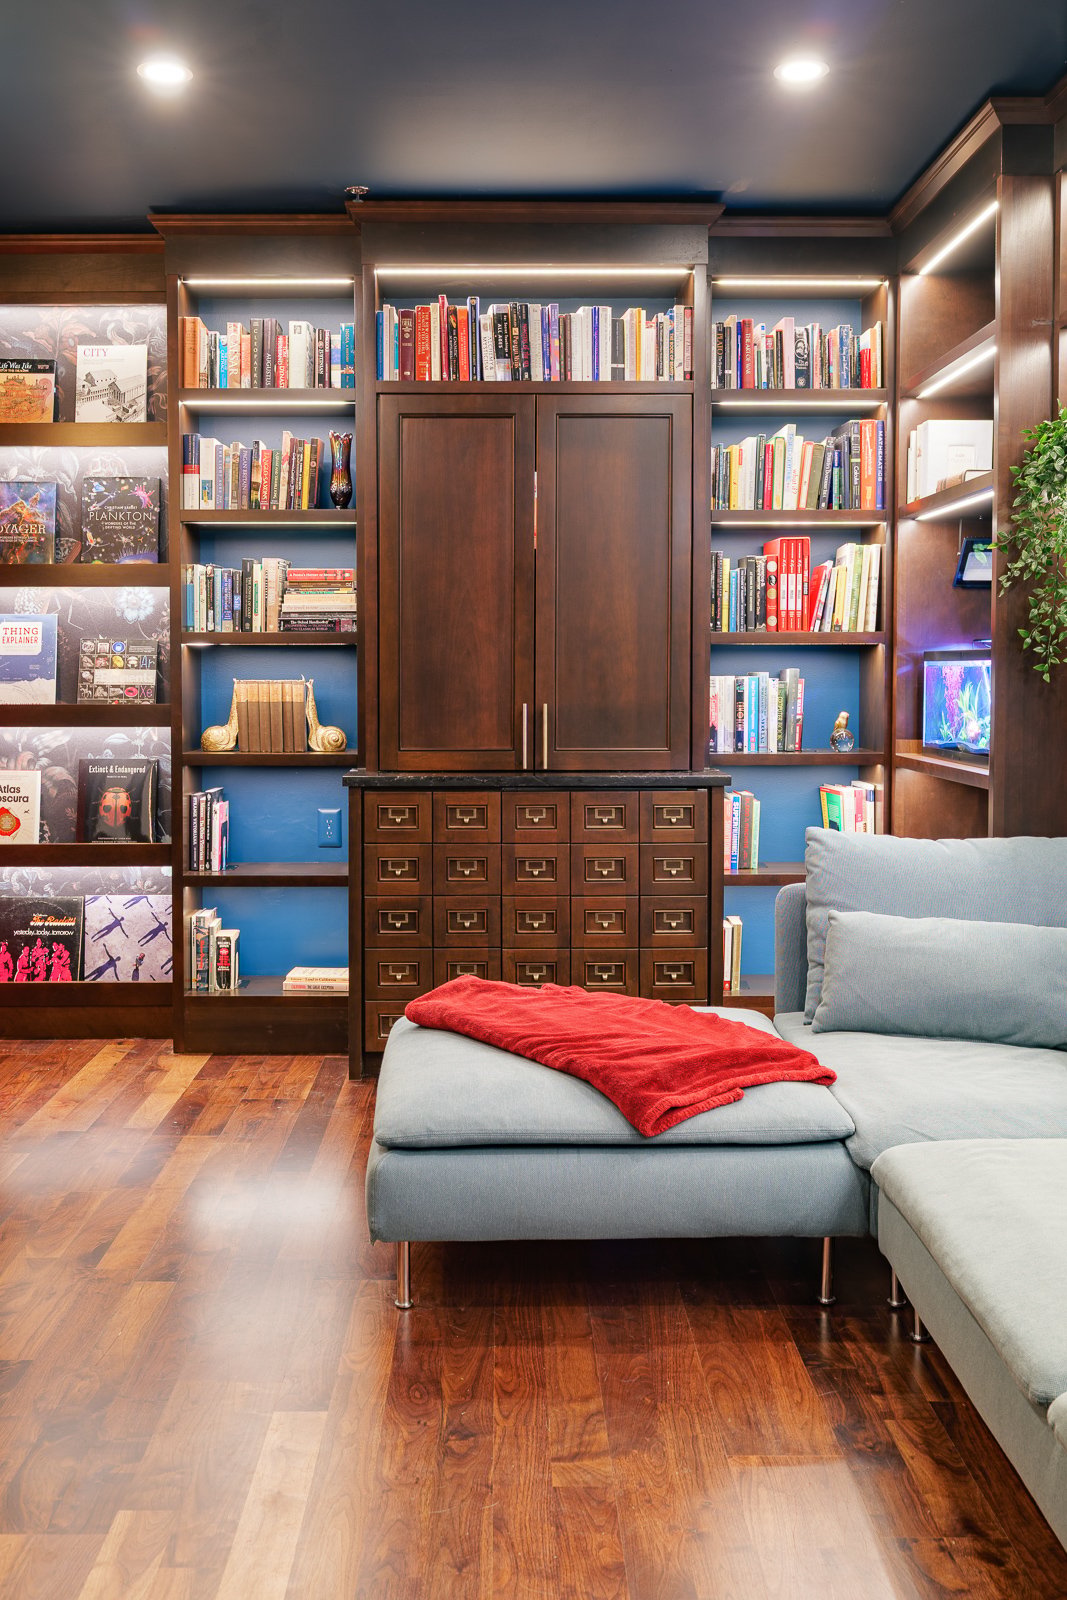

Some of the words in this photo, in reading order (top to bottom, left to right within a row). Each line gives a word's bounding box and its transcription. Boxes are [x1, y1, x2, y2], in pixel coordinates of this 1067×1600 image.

[716, 333, 724, 355] PLATO
[83, 348, 109, 357] CITY
[228, 331, 239, 376] CAESAR
[89, 511, 152, 521] PLANKTON
[2, 627, 39, 635] THING
[2, 636, 39, 644] EXPLAINER
[140, 655, 155, 669] Ar
[140, 685, 153, 698] Xe
[88, 765, 108, 773] Extinct
[109, 765, 114, 773] &
[115, 765, 146, 774] Endangered
[0, 785, 21, 794] Atlas
[0, 795, 29, 803] scura
